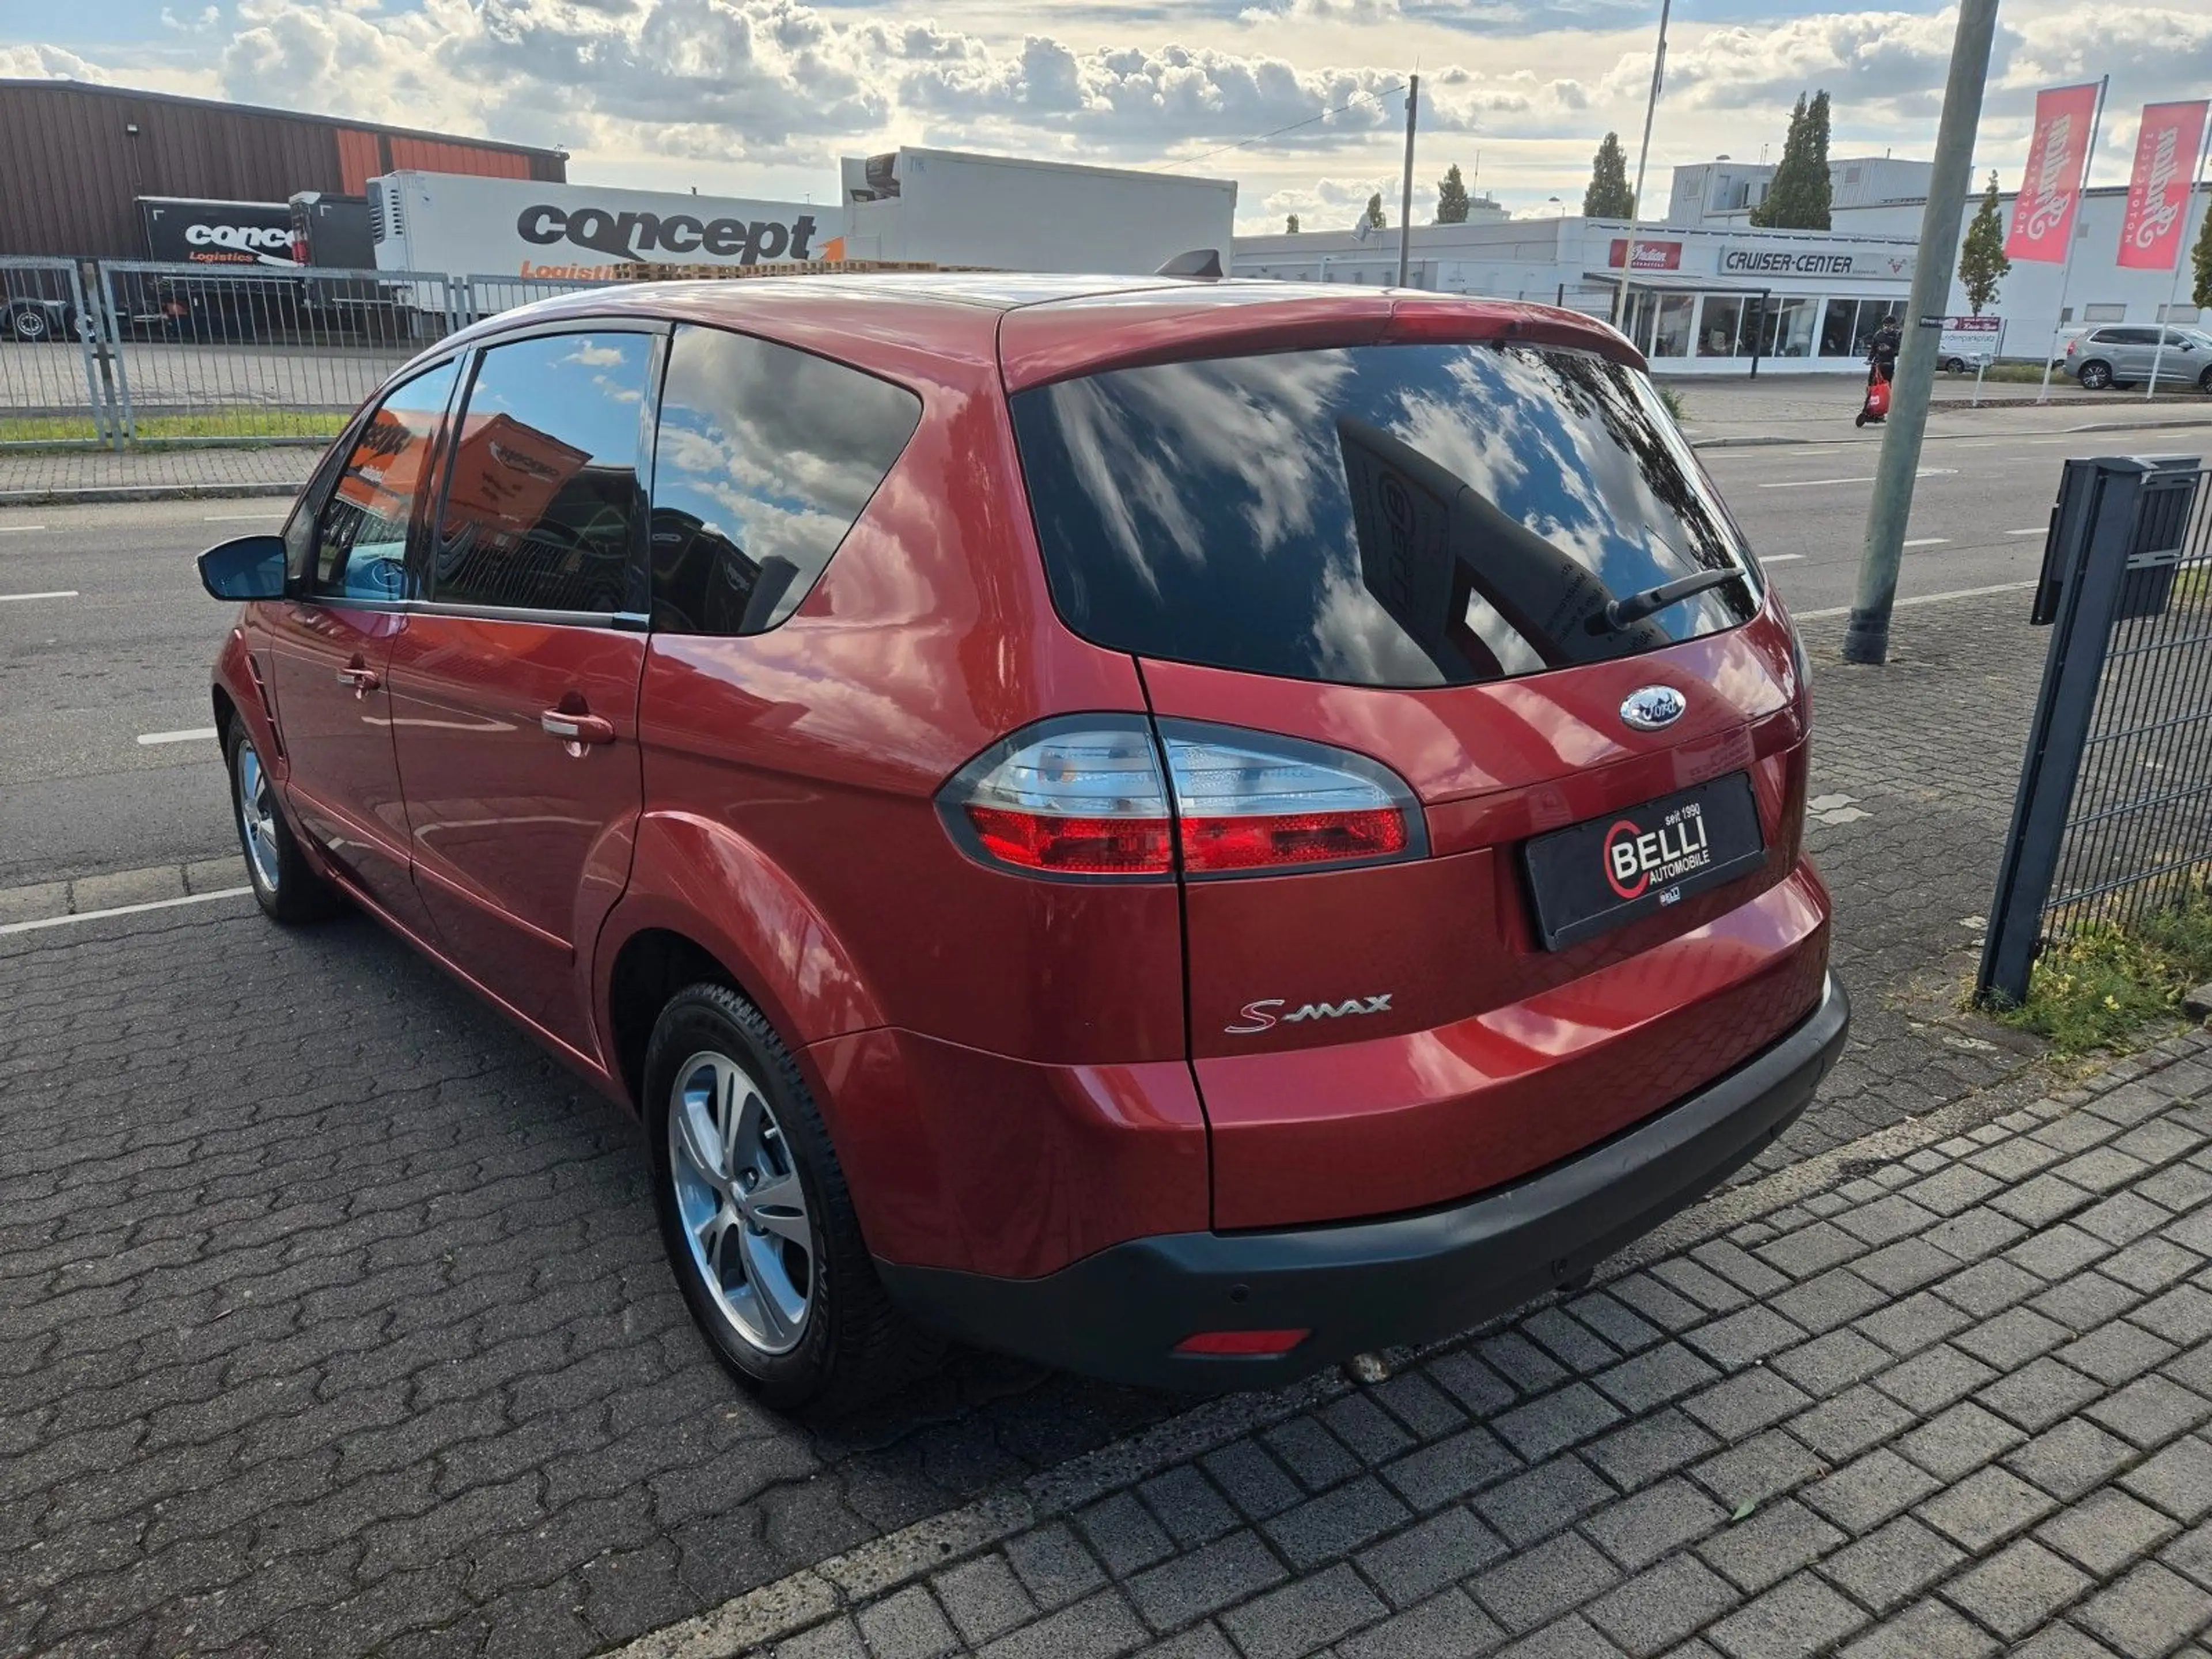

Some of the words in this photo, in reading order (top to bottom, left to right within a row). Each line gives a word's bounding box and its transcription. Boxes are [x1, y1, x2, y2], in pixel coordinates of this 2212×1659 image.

[517, 205, 816, 265] concept
[189, 251, 253, 263] Logistics
[521, 260, 614, 279] Logisti
[1726, 251, 1853, 274] CRUISER-CENTER
[1639, 693, 1677, 720] Ford
[1665, 810, 1681, 826] seit
[1681, 803, 1700, 820] 1990
[1612, 816, 1707, 880] BELLI
[1650, 849, 1710, 885] AUTOMOBILE
[1224, 994, 1393, 1033] S-MAX
